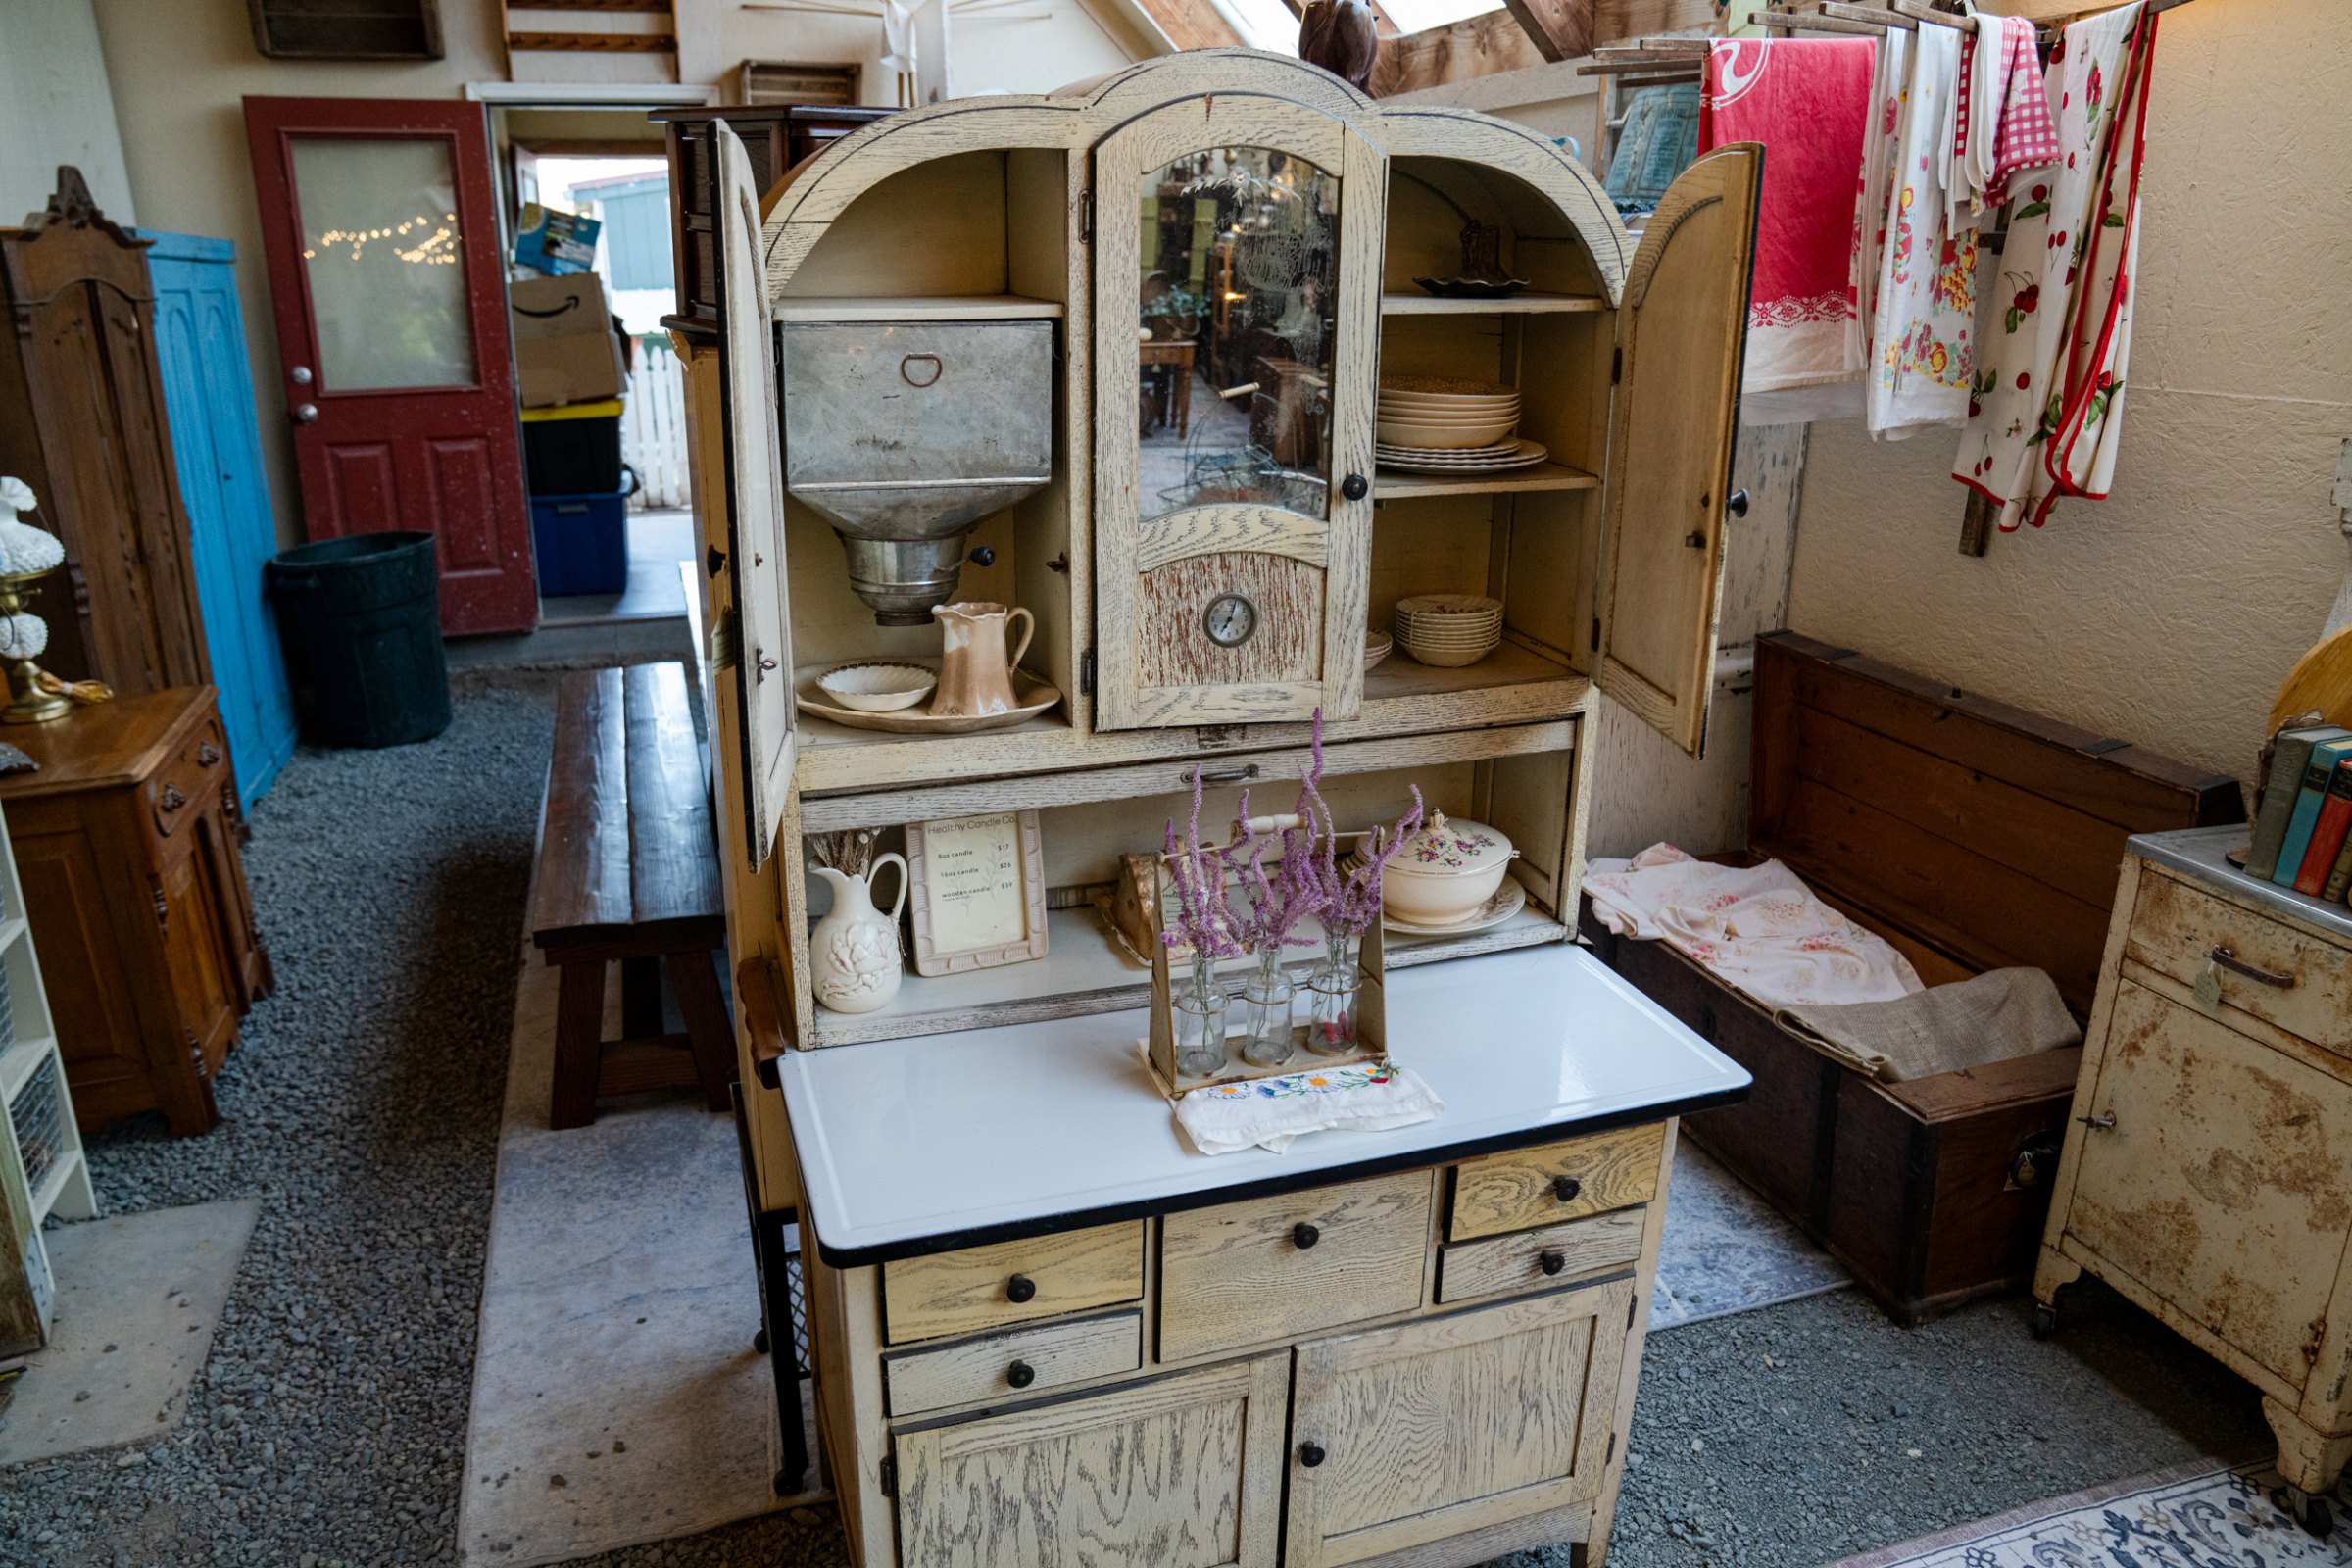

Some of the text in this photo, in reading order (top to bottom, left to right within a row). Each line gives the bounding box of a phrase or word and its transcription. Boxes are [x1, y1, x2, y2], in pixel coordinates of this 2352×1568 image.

[928, 822, 966, 835] Healthy
[967, 818, 1001, 829] Candle
[957, 867, 979, 876] candle
